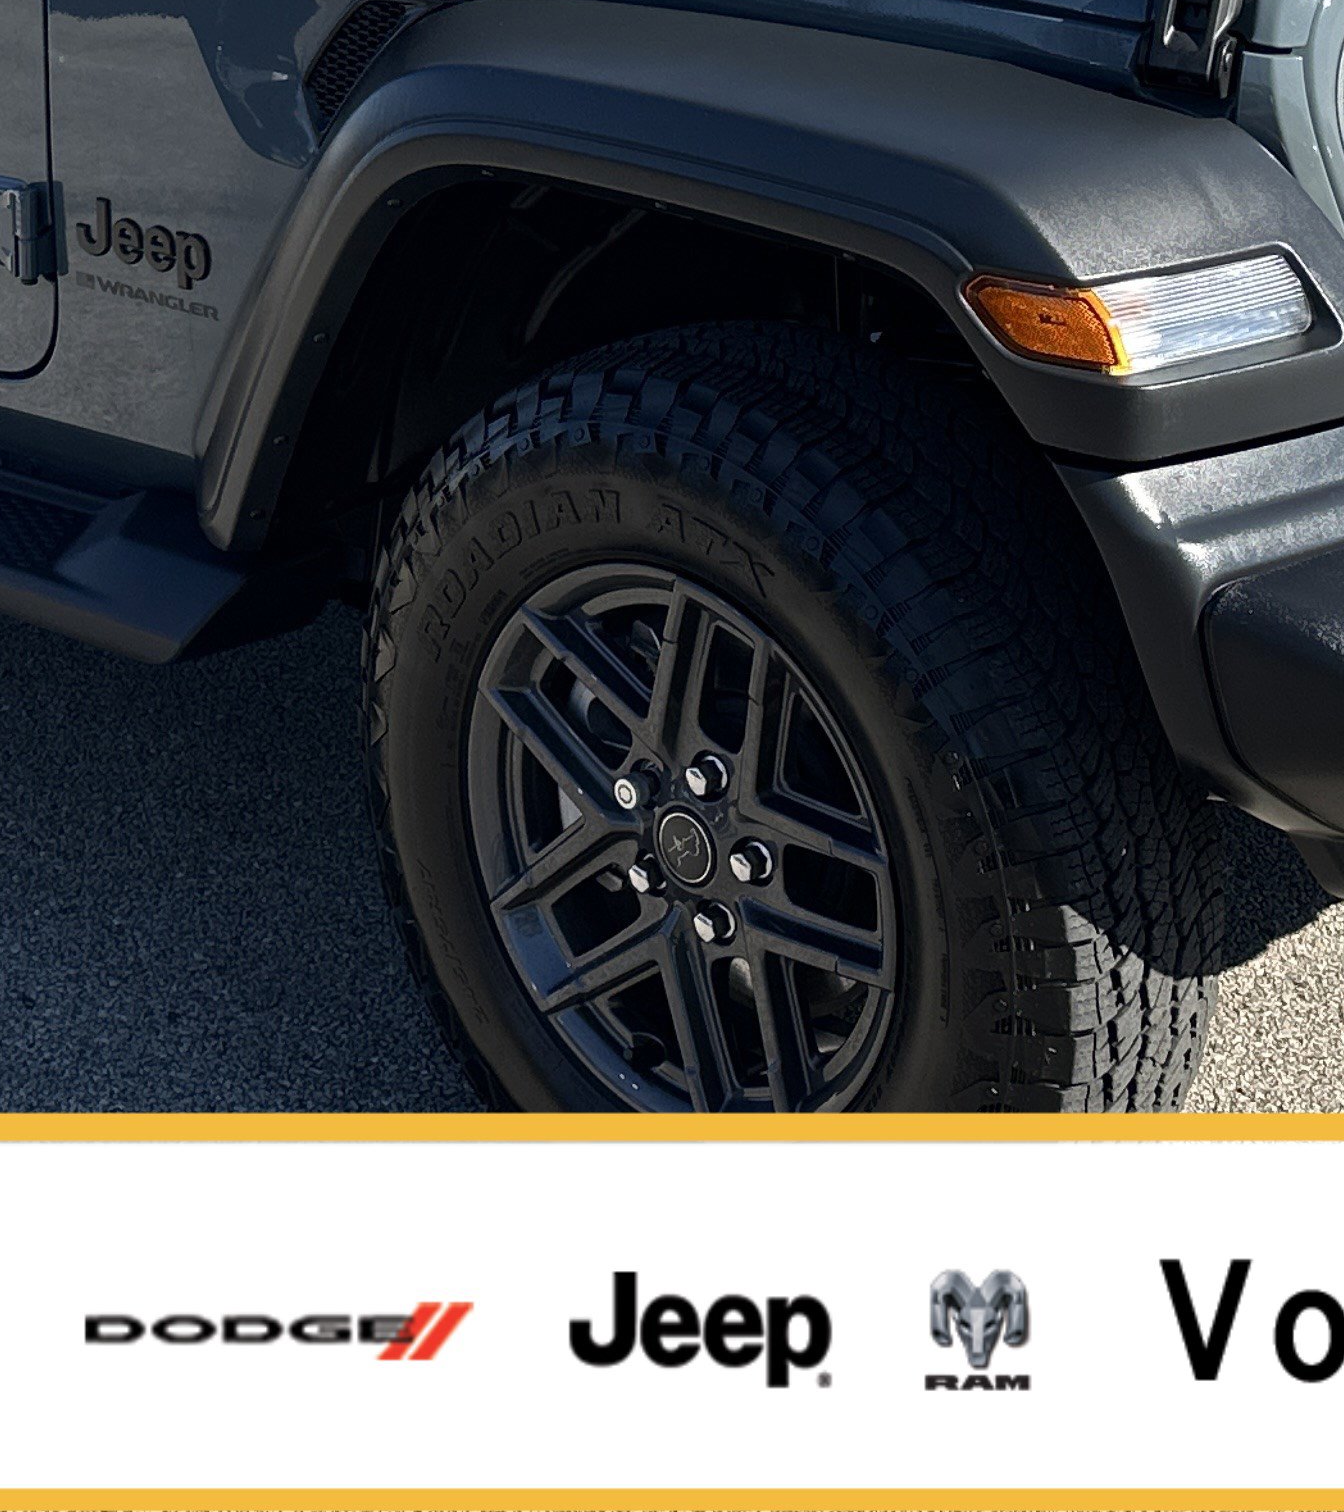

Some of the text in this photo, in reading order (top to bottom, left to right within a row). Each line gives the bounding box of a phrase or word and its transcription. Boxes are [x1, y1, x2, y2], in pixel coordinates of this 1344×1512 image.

[76, 197, 212, 290] Jeep
[96, 275, 219, 321] WRANGLER
[654, 501, 776, 599] ATX
